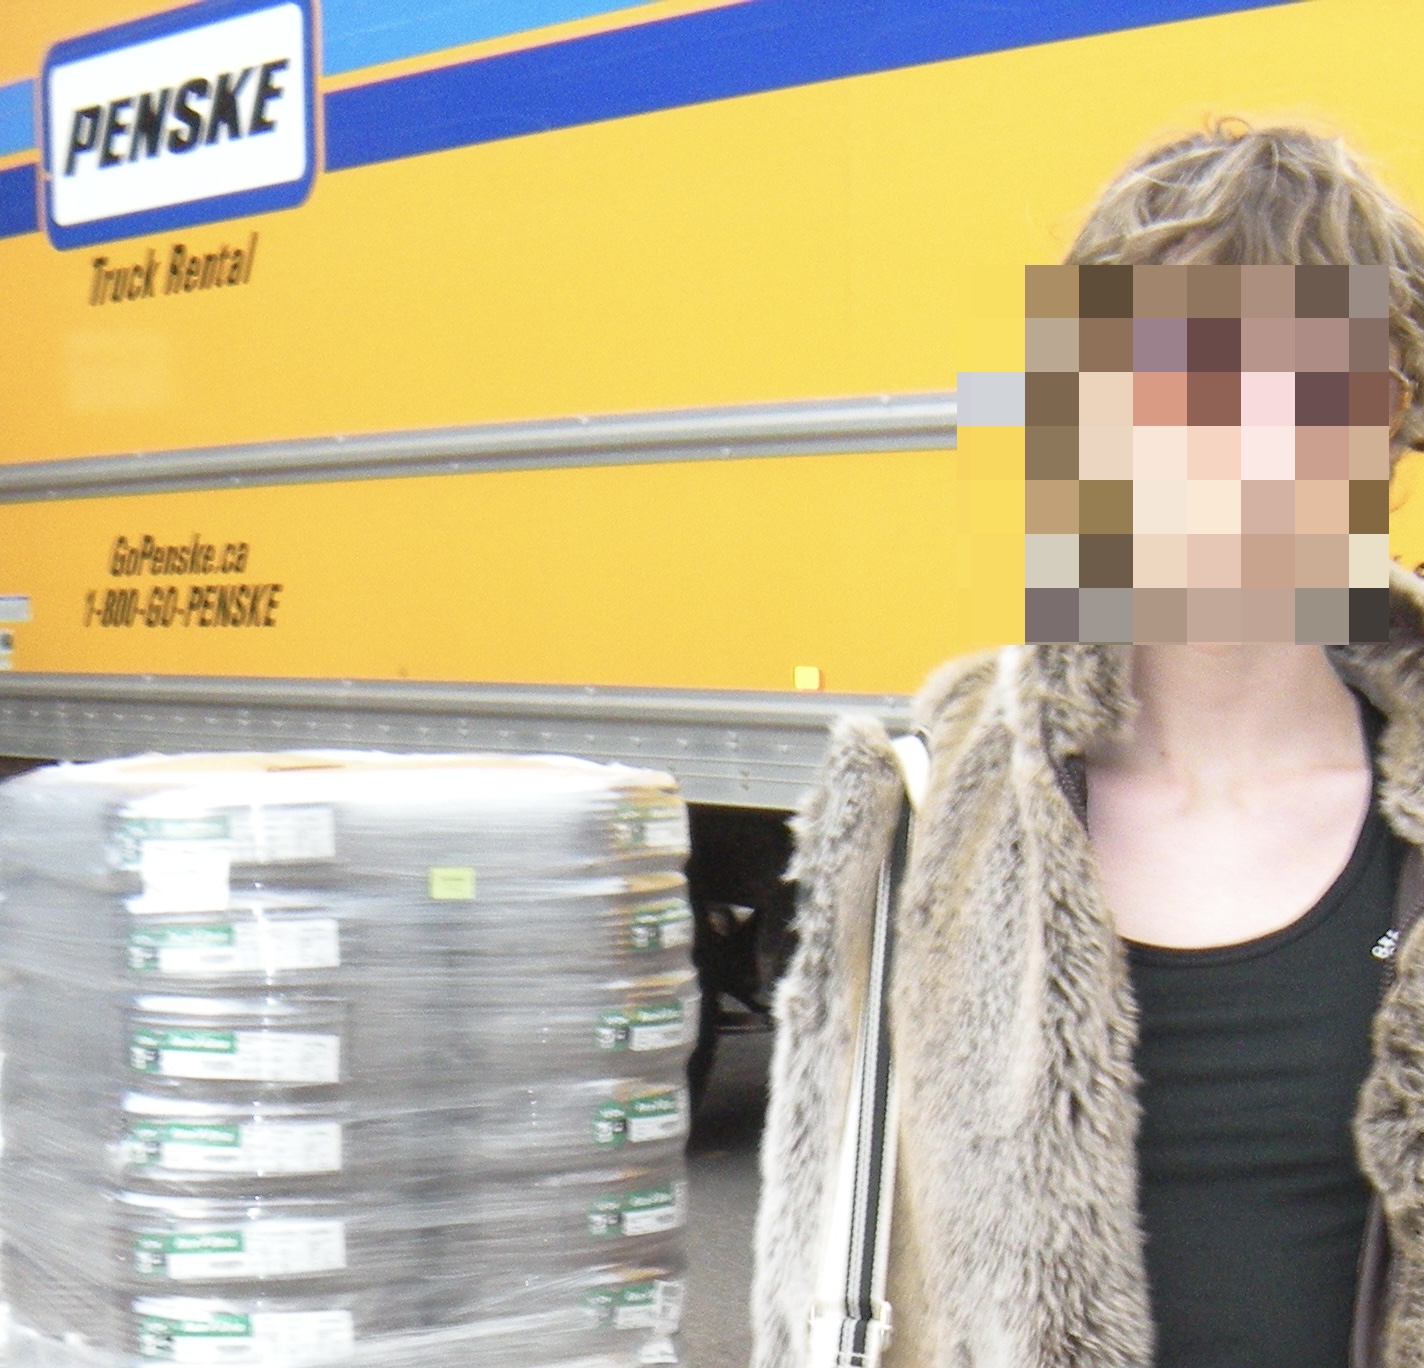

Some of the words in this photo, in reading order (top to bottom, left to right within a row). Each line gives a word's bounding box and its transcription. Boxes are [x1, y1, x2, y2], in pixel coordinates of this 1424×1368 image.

[63, 57, 291, 178] PENSKE
[89, 248, 160, 306] Truck
[164, 231, 260, 296] Rental
[108, 533, 250, 577] GoPenske.ca
[83, 583, 284, 628] 1-800-GO-PENSKE
